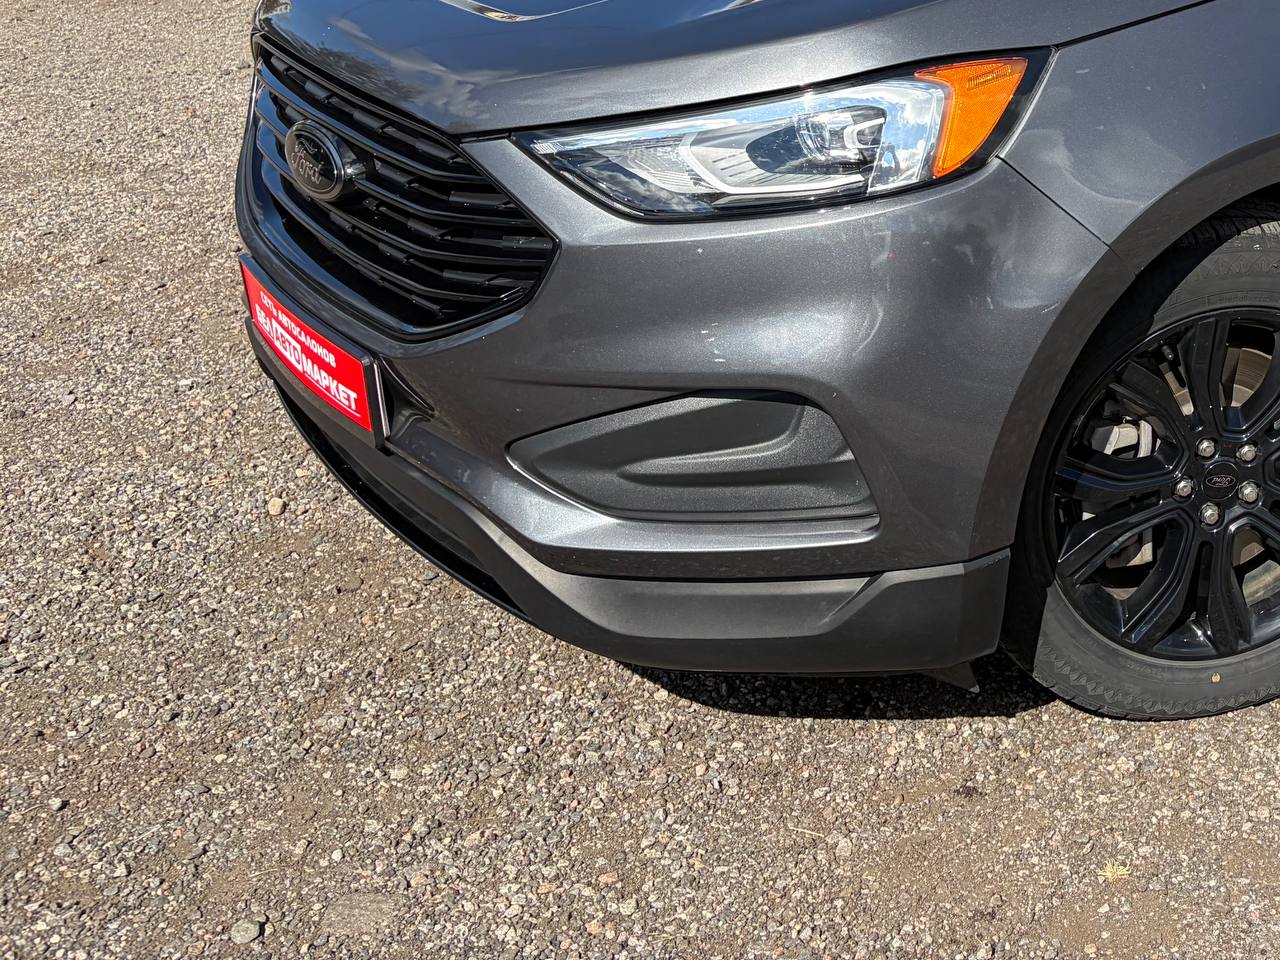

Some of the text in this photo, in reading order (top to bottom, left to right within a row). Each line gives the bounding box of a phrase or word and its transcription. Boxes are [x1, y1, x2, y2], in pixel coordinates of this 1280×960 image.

[290, 138, 322, 185] Ford
[255, 303, 358, 411] БЕЛ АВТО МАРКЕТ
[260, 291, 337, 368] СЕТЬ АВТОСАЛОНОВ
